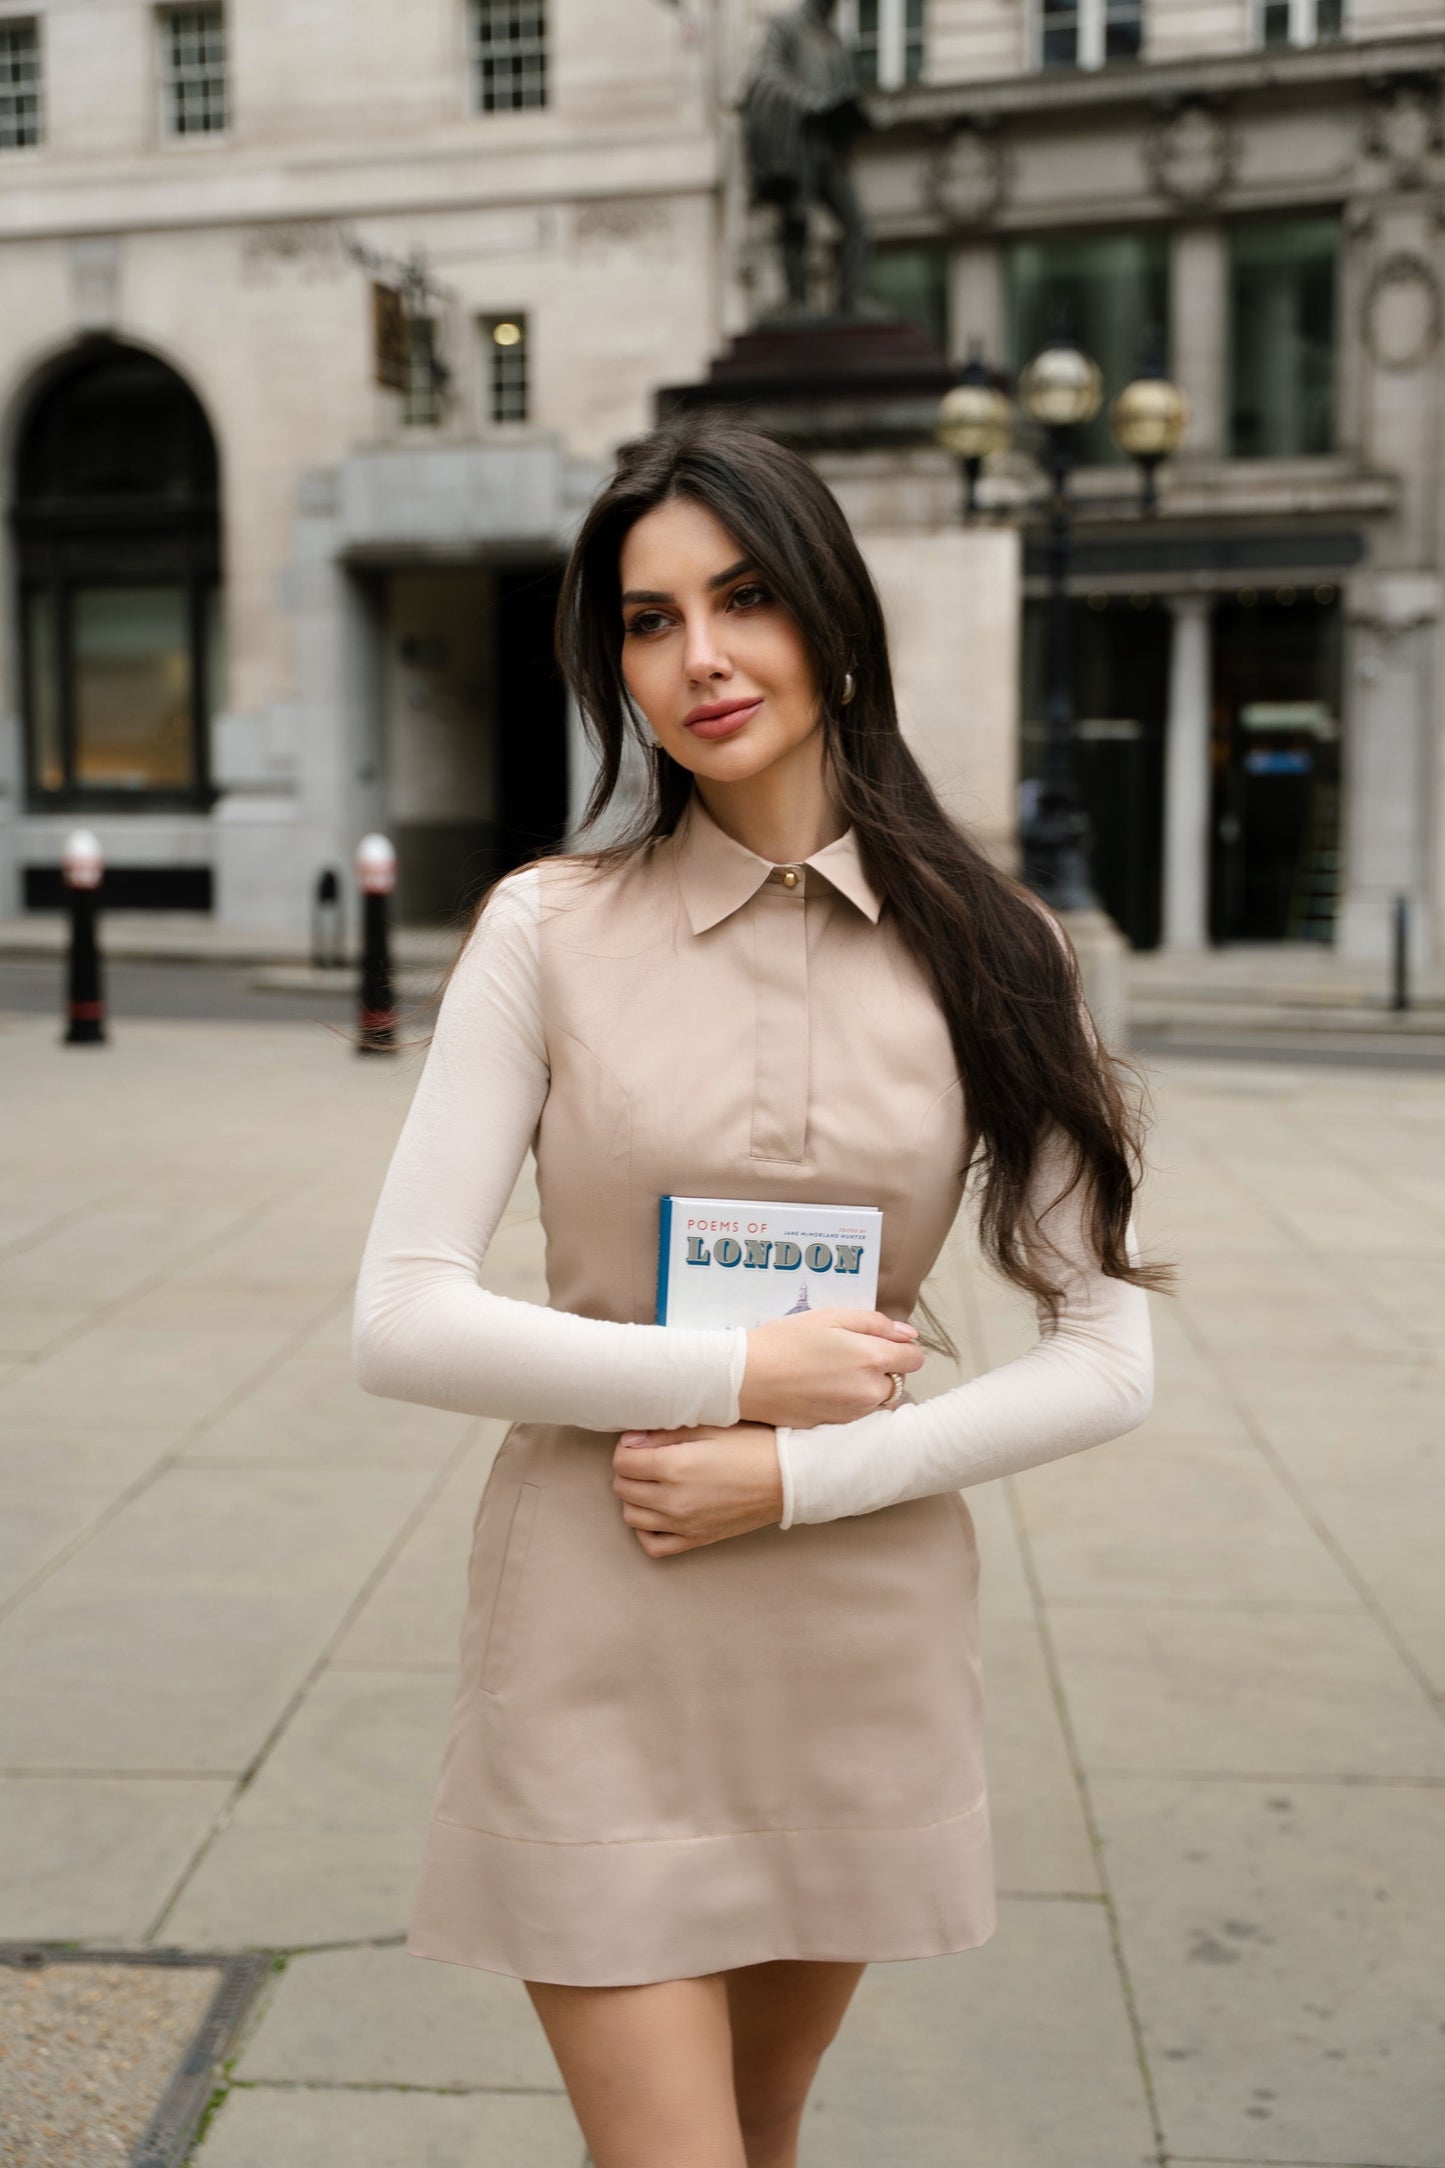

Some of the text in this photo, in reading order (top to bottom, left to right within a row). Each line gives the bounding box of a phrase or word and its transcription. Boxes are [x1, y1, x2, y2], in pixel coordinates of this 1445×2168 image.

[687, 1219, 768, 1234] POEMS OF
[686, 1236, 864, 1274] LONDON
